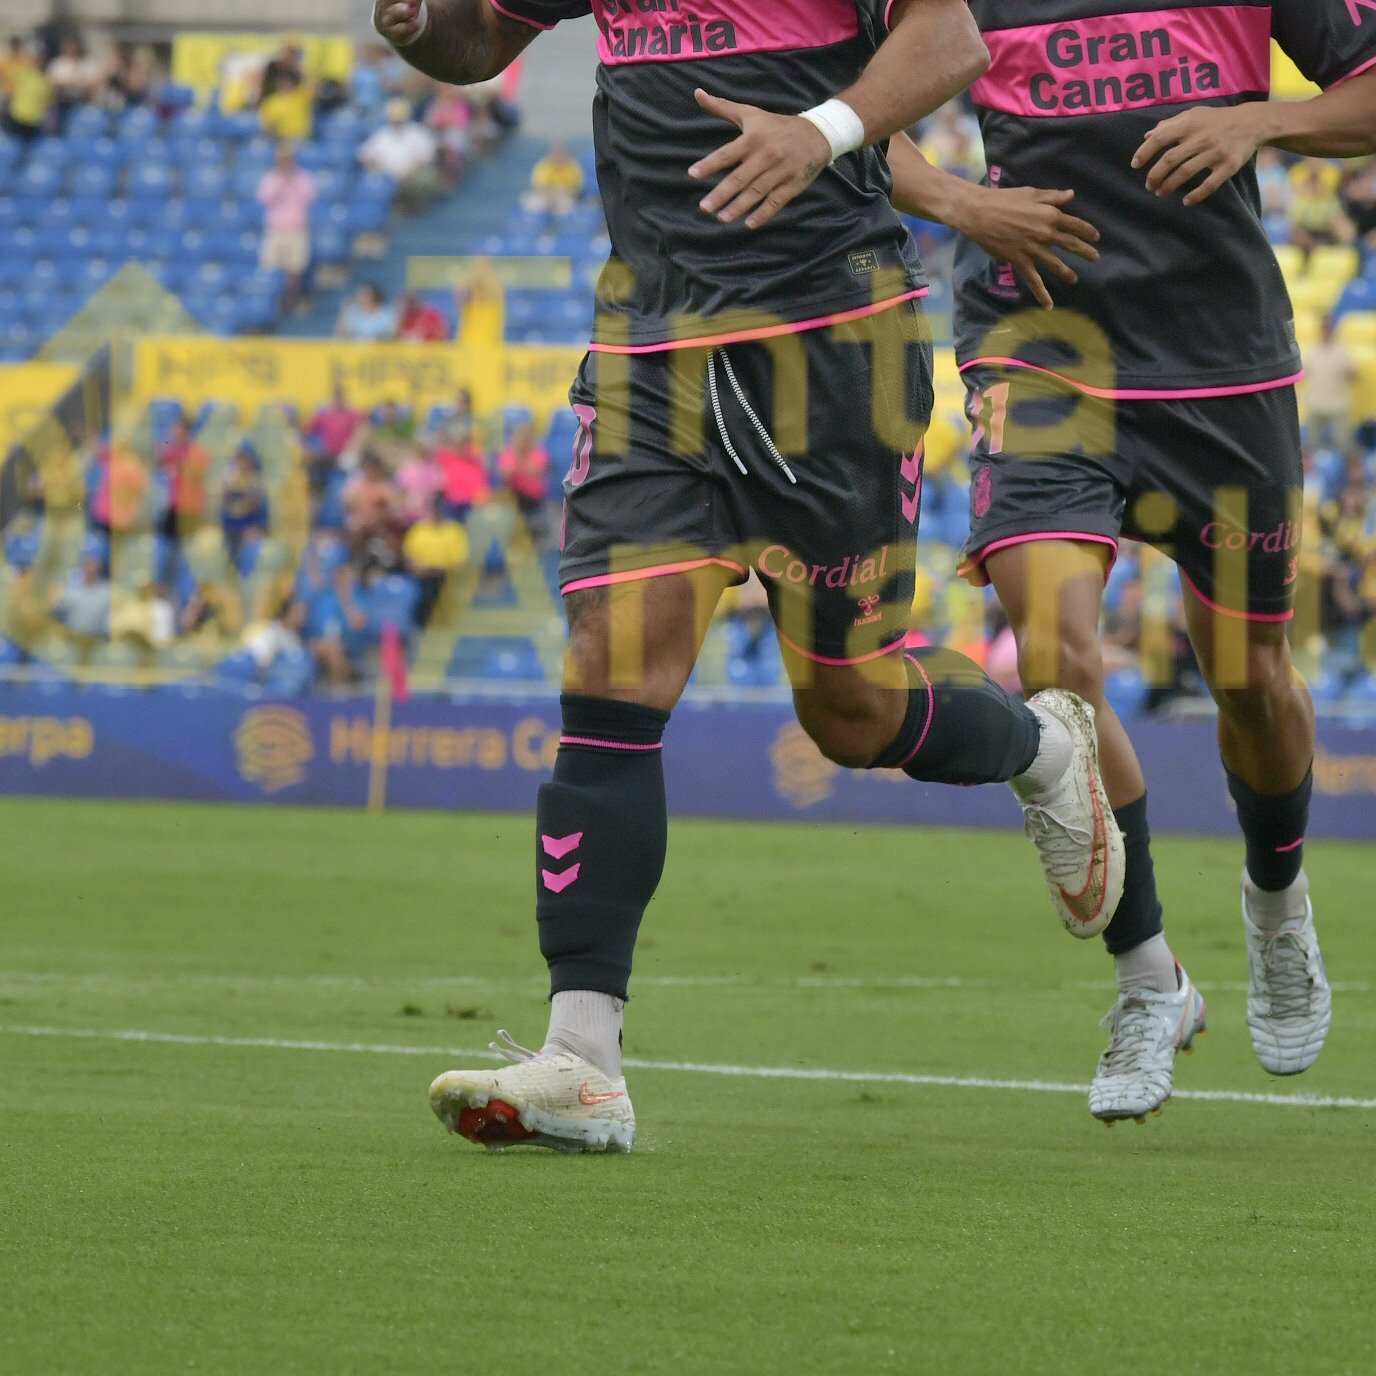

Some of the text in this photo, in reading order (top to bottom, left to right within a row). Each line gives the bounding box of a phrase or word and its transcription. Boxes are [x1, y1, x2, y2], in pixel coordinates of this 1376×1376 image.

[1045, 27, 1173, 70] Gran
[1028, 56, 1222, 111] Canaria
[758, 543, 889, 590] Cordial
